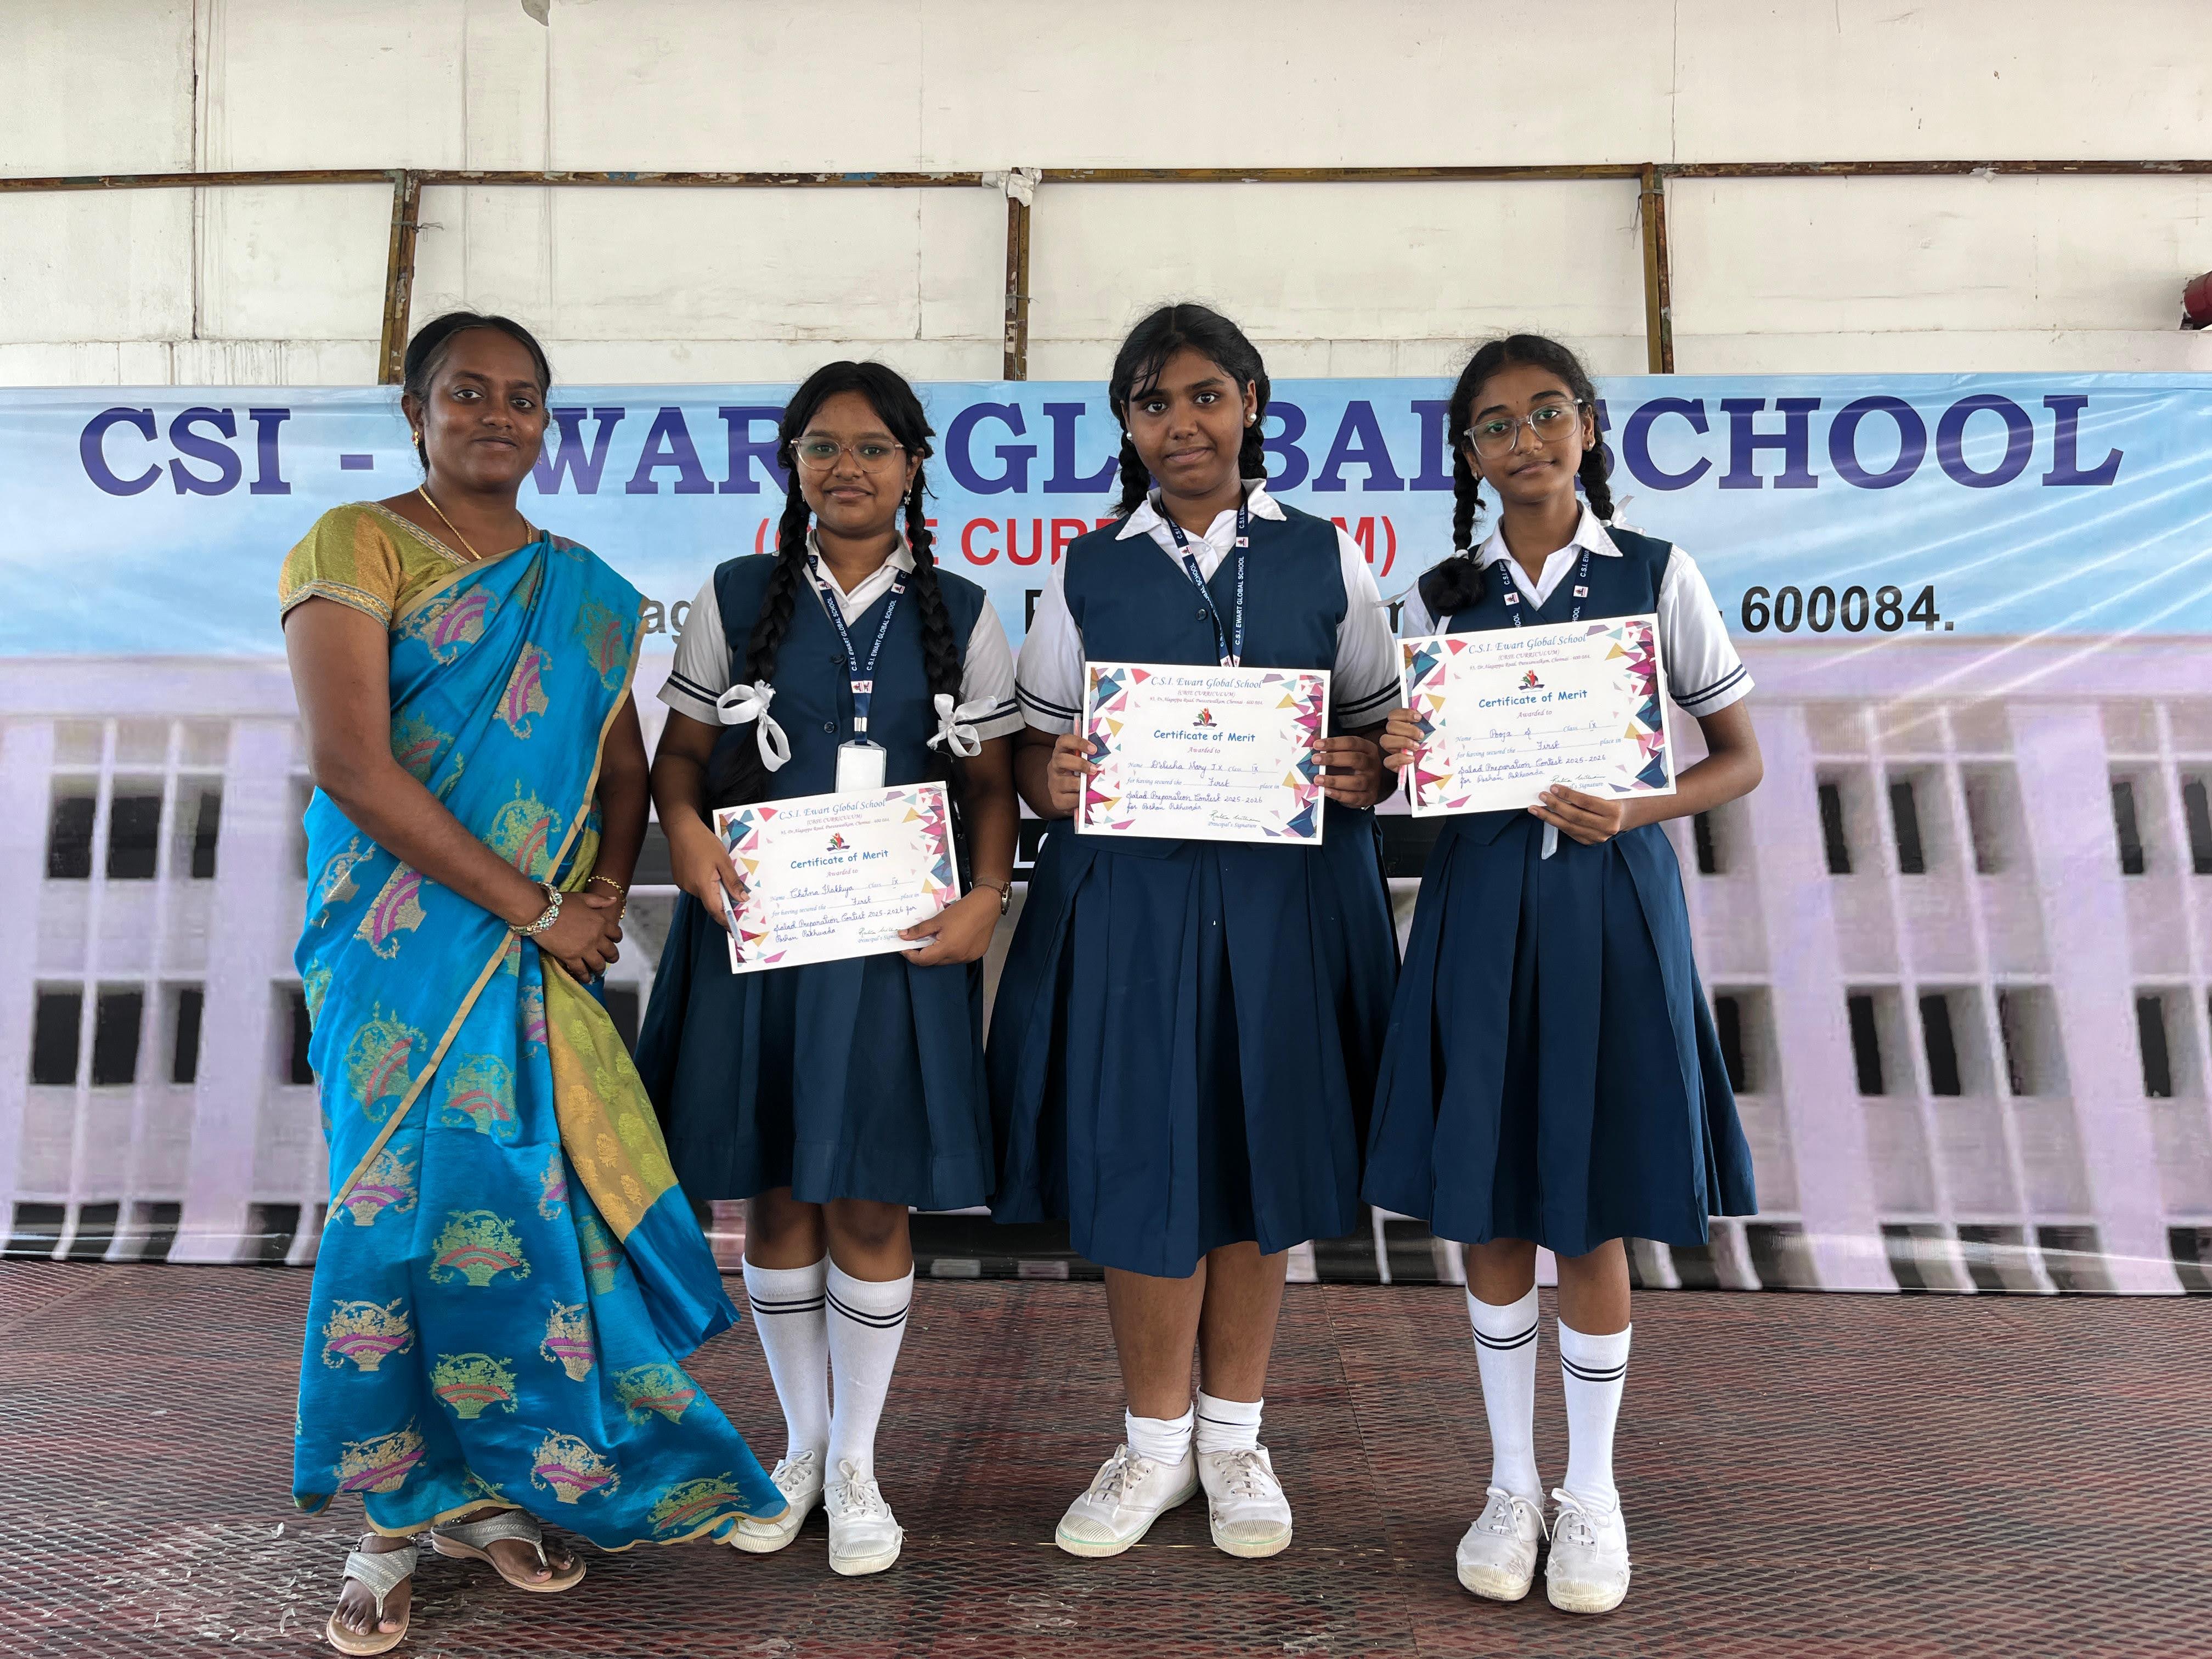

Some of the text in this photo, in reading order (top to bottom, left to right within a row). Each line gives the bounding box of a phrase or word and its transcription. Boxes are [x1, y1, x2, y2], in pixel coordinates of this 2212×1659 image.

[80, 395, 2124, 497] CSI - WAR GLBAL CHOOL
[1189, 562, 1203, 586] SCHOOL
[827, 597, 839, 618] SCHOOL
[1572, 606, 1581, 622] HOOL
[1741, 585, 1954, 633] 600084.
[836, 618, 848, 636] GLOBAL
[867, 600, 897, 671] C.S.I. EWART GLOBAL SCHOOL
[843, 636, 854, 656] EWART
[1469, 634, 1587, 654] C.S.I. Ewart Global School
[1151, 676, 1263, 689] C.S.I. Ewart Global School
[1479, 690, 1587, 708] Certificate of Merit
[1516, 709, 1545, 719] Awarded
[1154, 730, 1256, 742] Certificate of Merit
[1489, 729, 1512, 742] Pooja
[1589, 720, 1596, 732] IX
[1456, 752, 1465, 760] for
[1486, 747, 1506, 755] secured
[1537, 741, 1560, 750] First
[1600, 738, 1613, 746] place
[1252, 764, 1259, 774] IX
[1458, 764, 1483, 777] Salad
[1486, 759, 1531, 776] Preparation
[1536, 756, 1562, 767] Contest
[1209, 777, 1229, 787] First
[1460, 777, 1471, 789] for
[1126, 791, 1147, 804] Salad
[1151, 791, 1191, 805] Preparation
[1194, 793, 1221, 802] Contest
[779, 798, 887, 820] C.S.I. Ewart Global School
[1127, 802, 1138, 814] for
[791, 850, 889, 869] Certificate of Merit
[826, 868, 851, 878] Awarded
[891, 877, 898, 889] IX
[771, 910, 780, 918] for
[851, 896, 871, 905] First
[774, 921, 795, 936] Salad
[799, 915, 839, 932] Preparation
[842, 911, 865, 922] Contest
[906, 905, 917, 916] for
